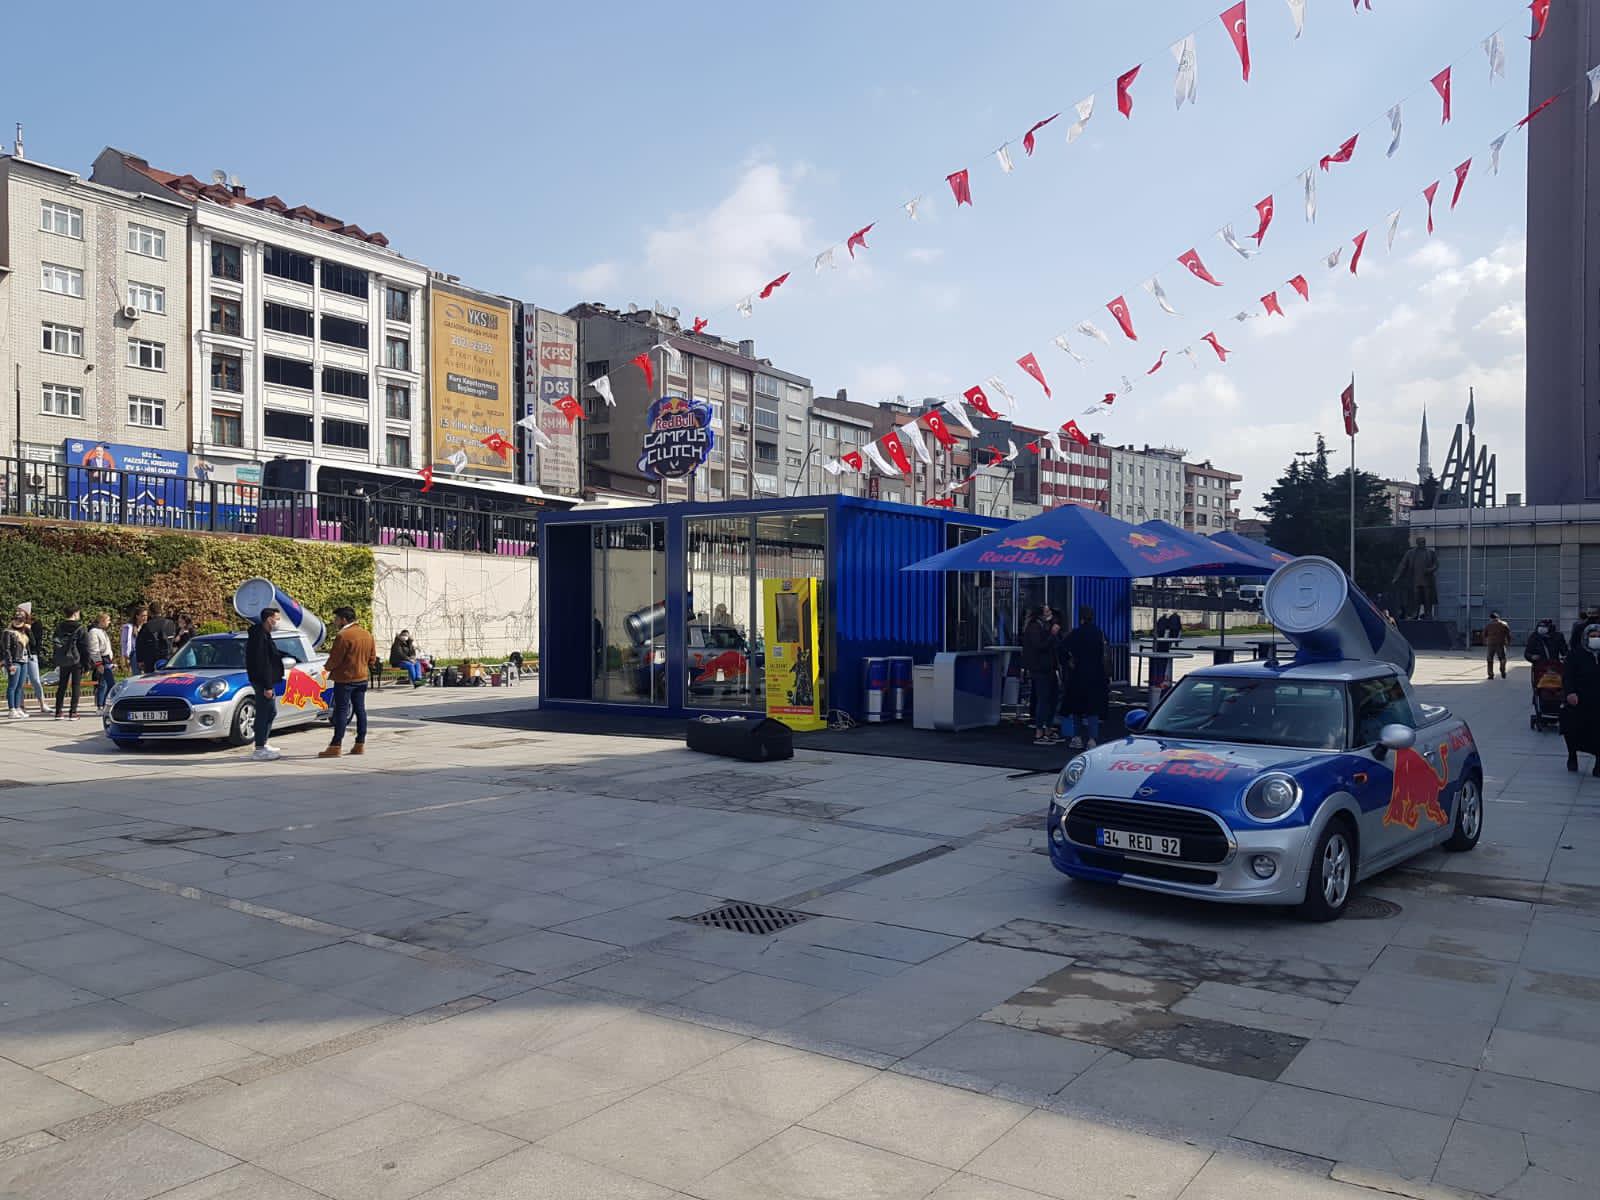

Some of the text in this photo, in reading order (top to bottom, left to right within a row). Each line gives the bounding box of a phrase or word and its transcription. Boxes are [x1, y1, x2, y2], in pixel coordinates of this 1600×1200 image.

[468, 308, 487, 326] YKS
[525, 314, 534, 393] MURAT
[542, 346, 571, 360] KPSS
[544, 380, 570, 394] DGS
[655, 412, 695, 430] Red Bull
[644, 427, 706, 449] CAMPUS
[647, 444, 703, 465] CLUTCH
[978, 551, 1065, 567] Red Bull
[1107, 759, 1231, 782] Red Bull
[1104, 830, 1178, 855] 34 RED 92
